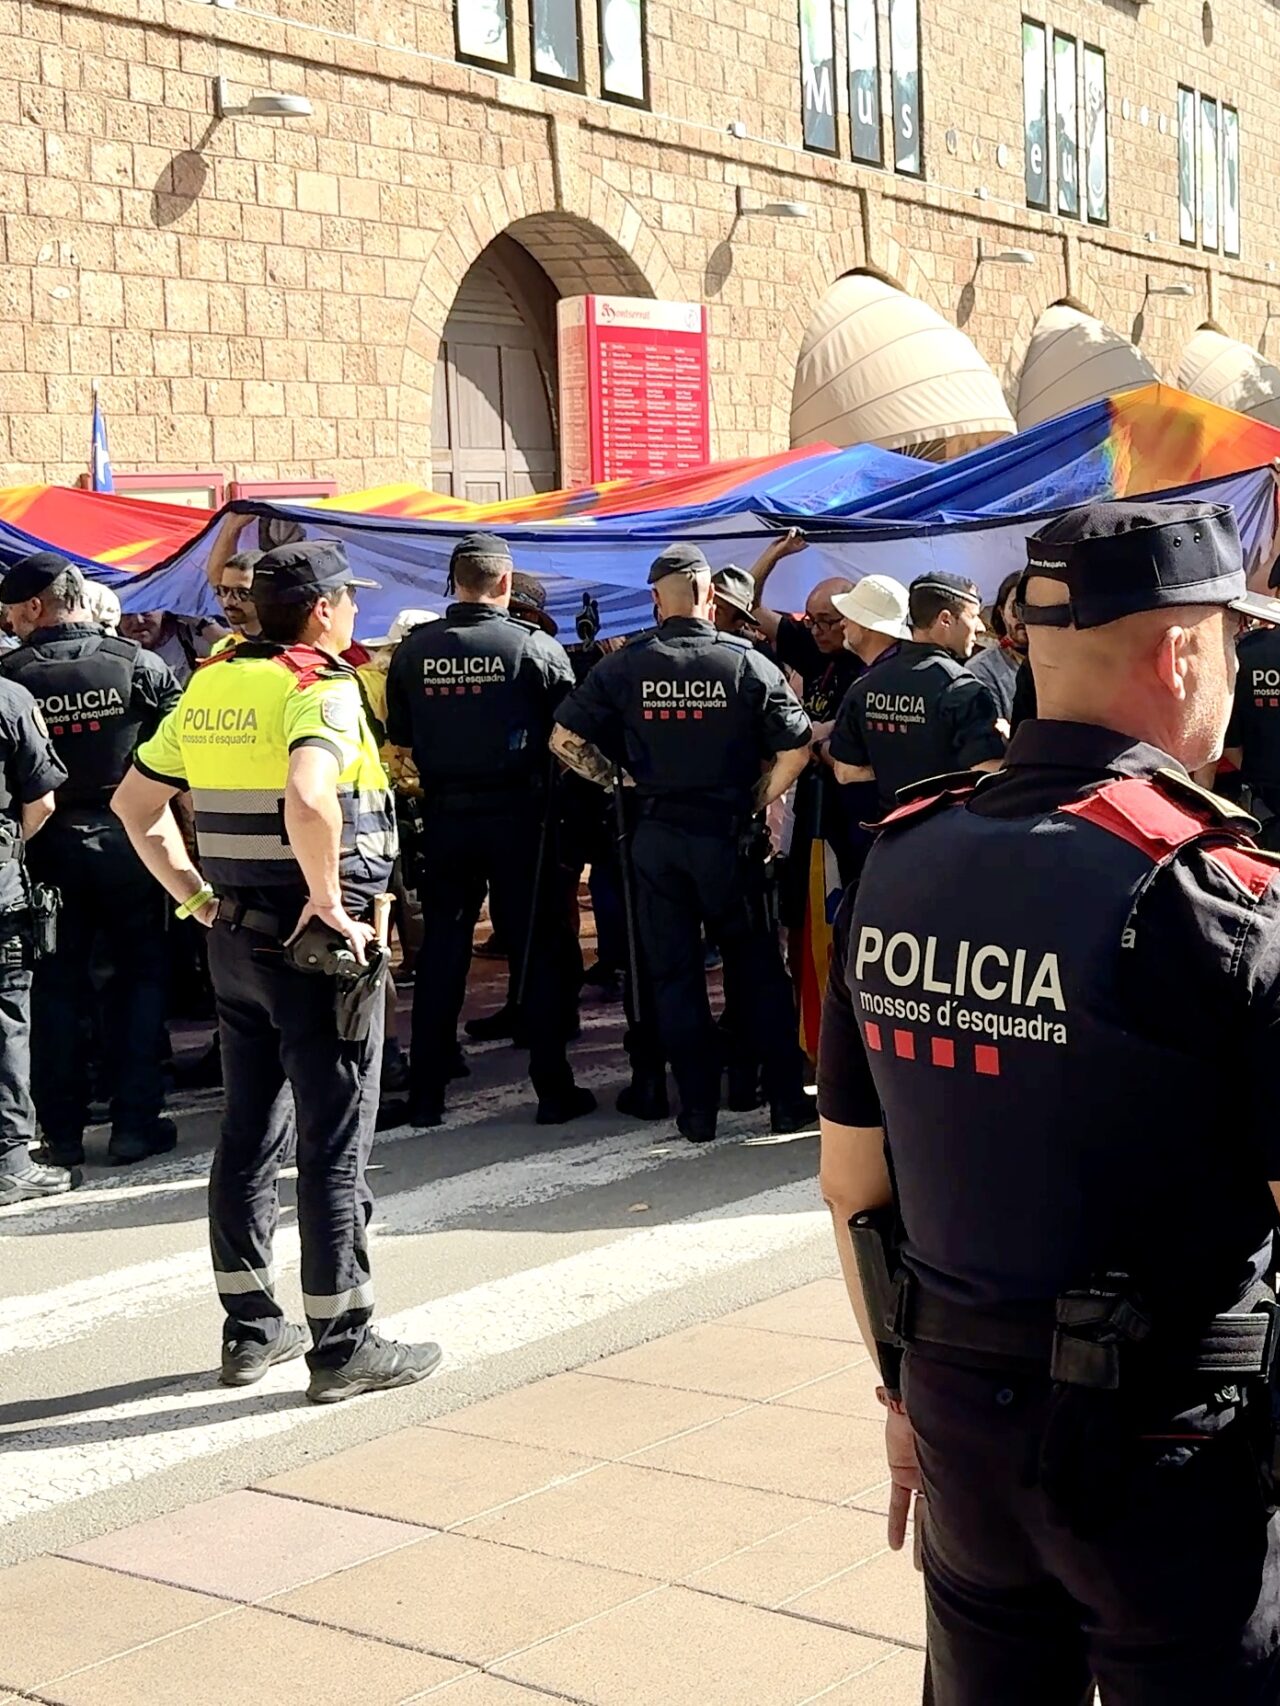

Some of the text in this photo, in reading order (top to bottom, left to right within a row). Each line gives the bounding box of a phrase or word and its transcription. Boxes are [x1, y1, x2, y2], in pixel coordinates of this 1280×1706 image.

[423, 656, 505, 675] POLICIA
[423, 677, 456, 685] mossos
[642, 680, 726, 698] POLICIA
[642, 700, 677, 708] mossos
[866, 692, 925, 713] POLICIA
[183, 708, 258, 731] POLICIA
[182, 734, 207, 744] mossos
[855, 926, 1066, 1012] POLICIA
[859, 990, 931, 1023] mossos
